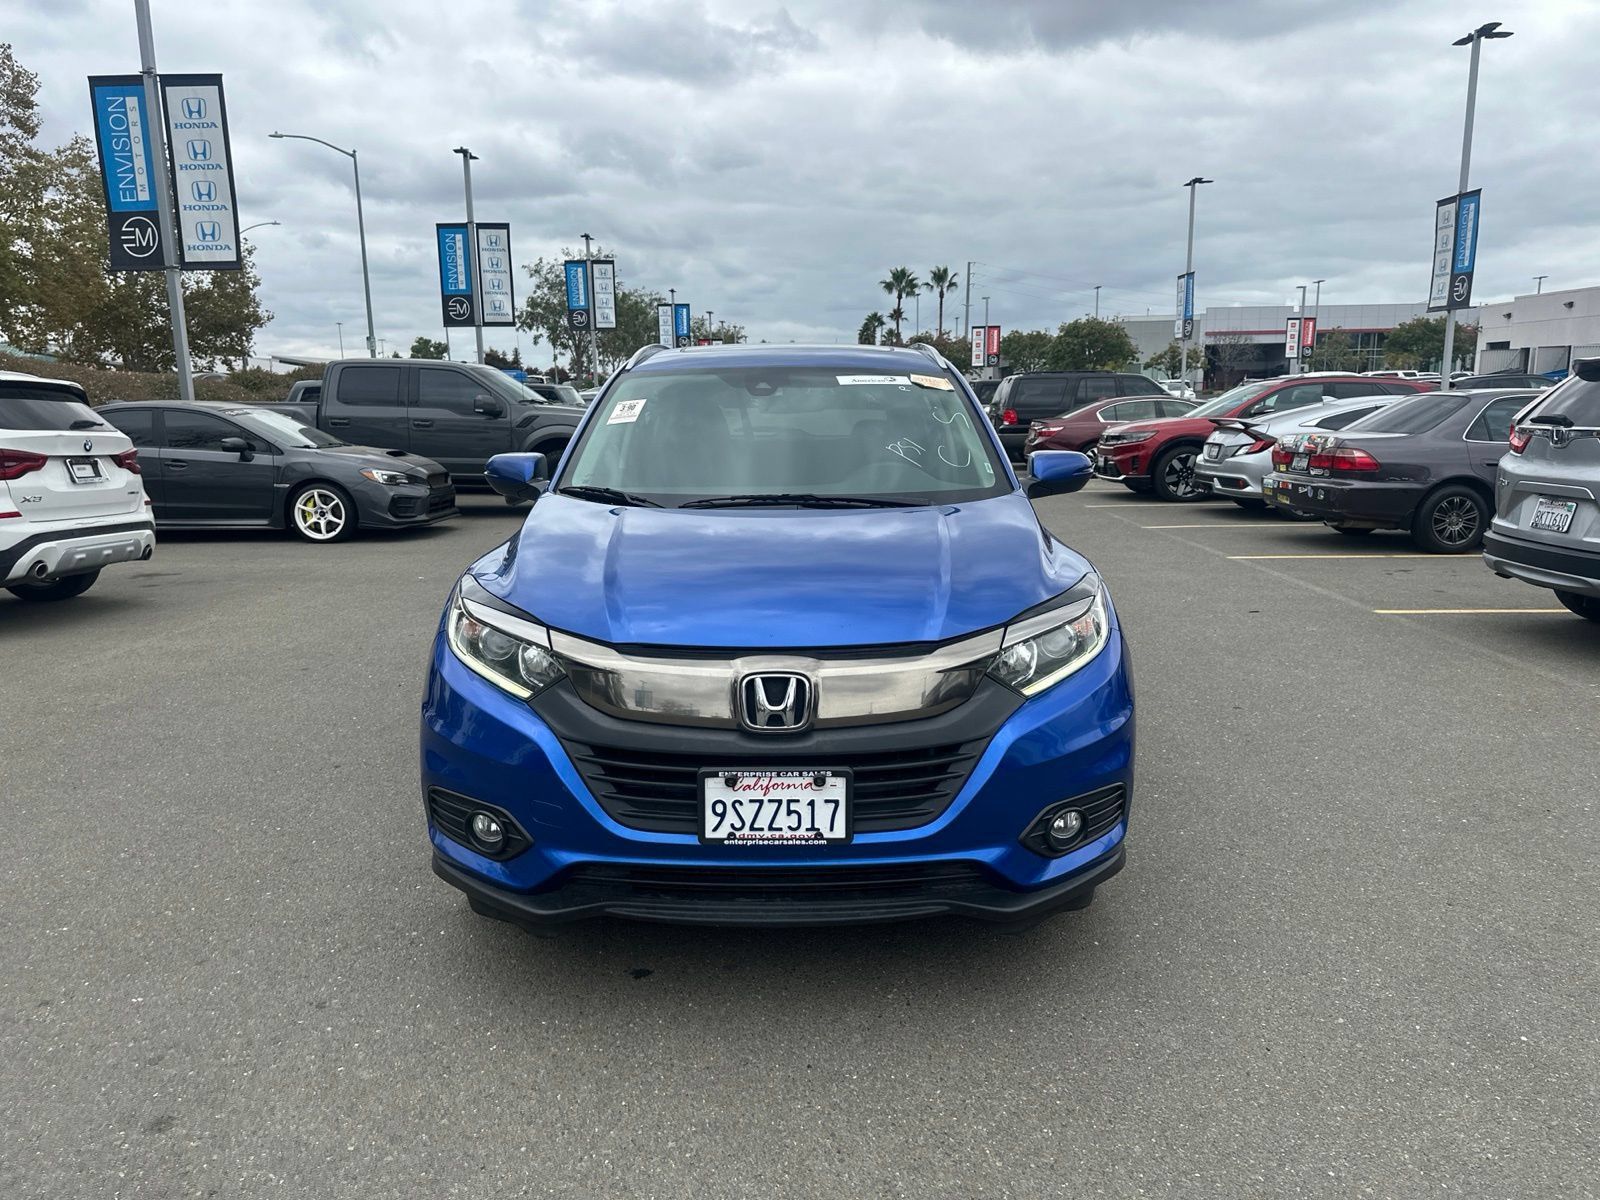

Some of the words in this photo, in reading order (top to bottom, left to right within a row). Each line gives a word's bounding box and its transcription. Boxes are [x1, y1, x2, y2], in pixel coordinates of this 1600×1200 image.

[106, 96, 137, 202] ENVISION
[130, 106, 147, 192] MOTORS
[179, 163, 223, 171] HONDA
[183, 204, 228, 212] HONDA
[445, 233, 459, 290] ENVISION
[570, 266, 580, 306] ENVISION
[20, 495, 42, 503] X3
[732, 775, 823, 797] California
[711, 799, 840, 832] 9SZZ517
[723, 839, 827, 847] enterprisecarsales.com
